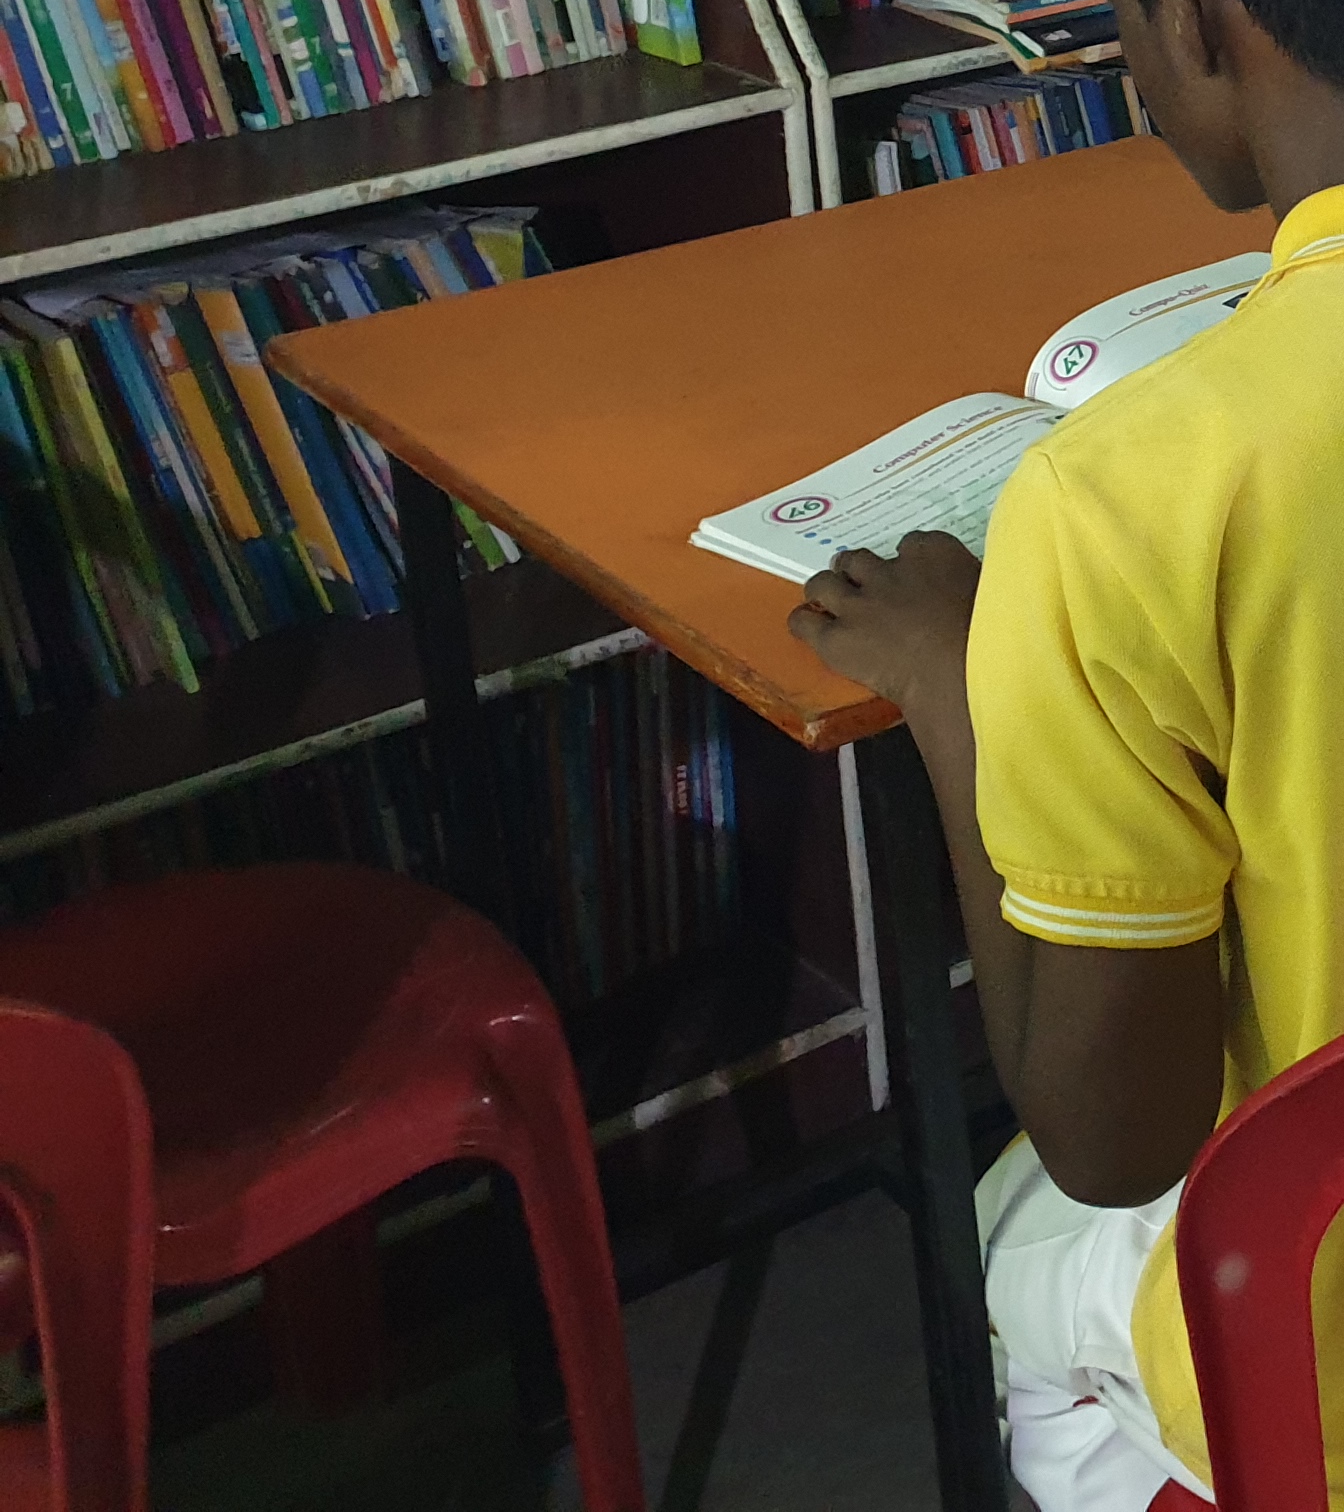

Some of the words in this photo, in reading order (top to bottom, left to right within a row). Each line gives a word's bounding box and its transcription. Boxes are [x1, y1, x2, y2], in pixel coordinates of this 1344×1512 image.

[1129, 283, 1210, 317] Compu-Quiz
[1063, 344, 1085, 375] 47
[873, 430, 945, 474] Computer
[946, 405, 1004, 433] Science
[787, 500, 821, 520] 46
